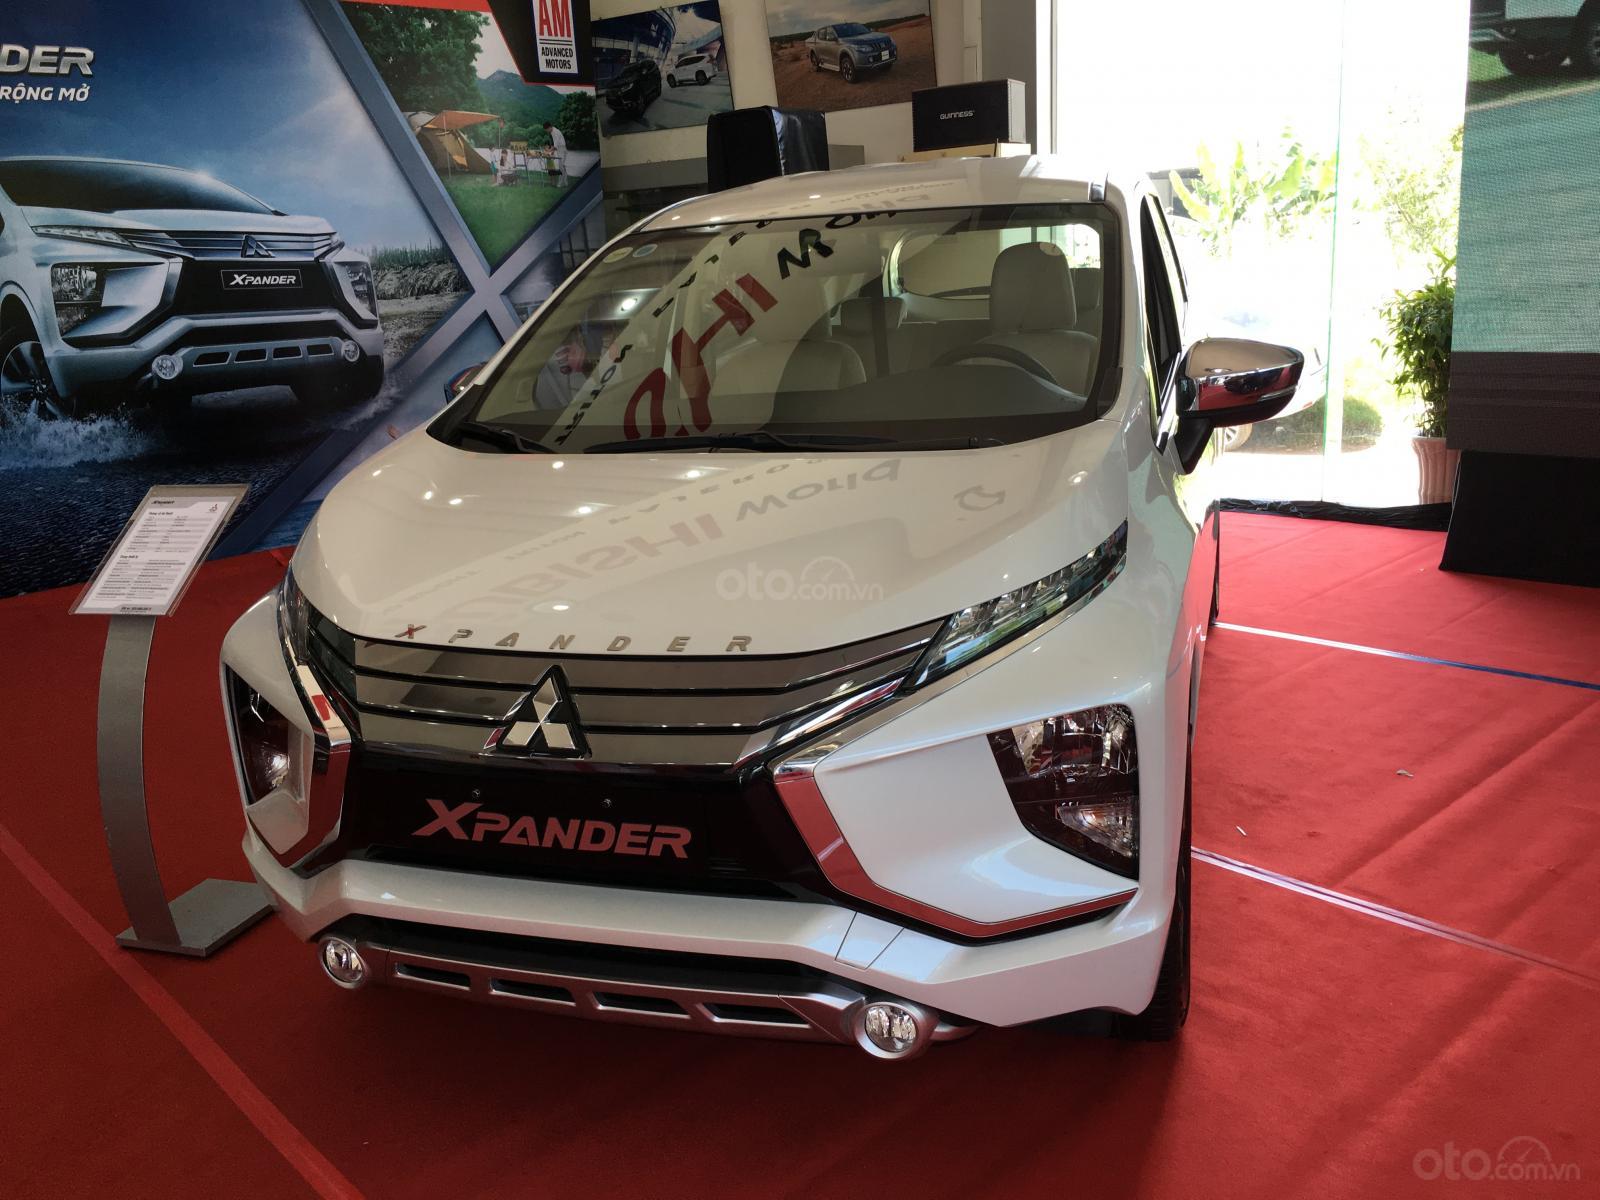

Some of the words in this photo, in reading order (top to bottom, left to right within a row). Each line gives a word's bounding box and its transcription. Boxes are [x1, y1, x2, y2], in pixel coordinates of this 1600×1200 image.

[538, 0, 572, 38] AM
[541, 46, 574, 58] ADVANCED
[545, 58, 572, 70] MOTORS
[58, 83, 91, 102] MỞ
[939, 110, 976, 120] GUINNESS
[229, 273, 297, 286] XPANDER
[394, 622, 753, 654] XPANDER
[410, 798, 693, 860] XPANDER
